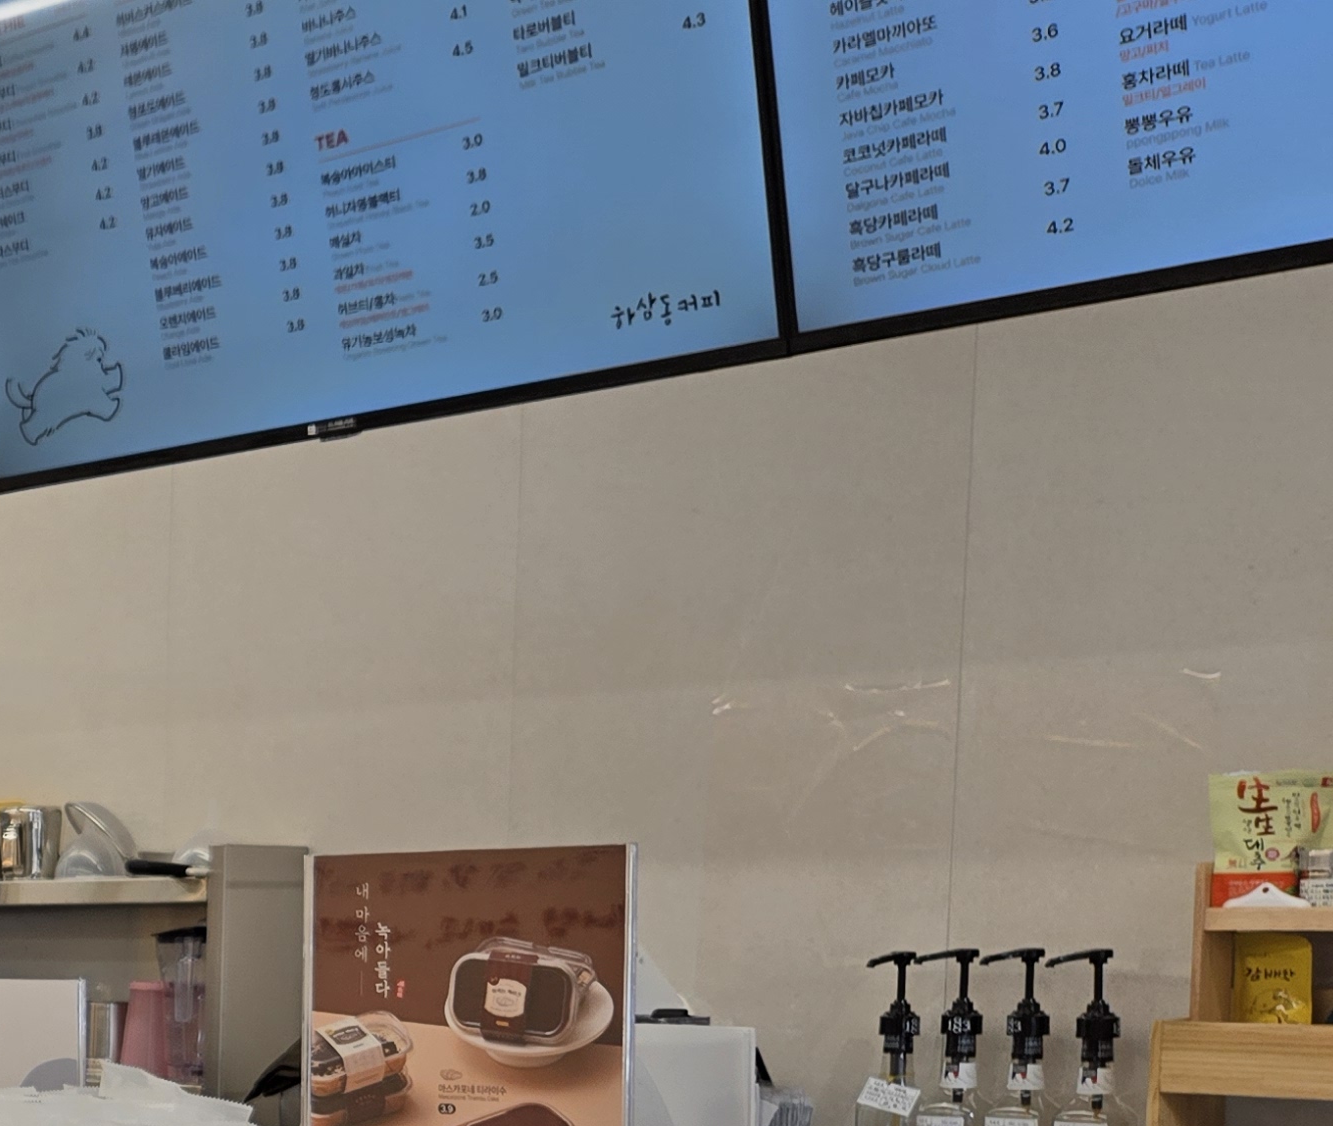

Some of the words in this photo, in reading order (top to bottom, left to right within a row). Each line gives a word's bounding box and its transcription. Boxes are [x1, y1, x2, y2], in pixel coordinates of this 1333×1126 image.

[450, 4, 468, 21] 4.1
[682, 12, 706, 30] 4.3
[1031, 22, 1059, 43] 3.6
[1119, 14, 1188, 46] 요거라떼
[452, 40, 474, 57] 4.5
[836, 62, 895, 90] 카페모카
[1034, 62, 1061, 82] 3.8
[1122, 59, 1190, 91] 홍차라떼
[839, 88, 943, 127] 자바칩카페모카
[1038, 101, 1064, 120] 3.7
[314, 128, 350, 151] TEA
[462, 133, 483, 151] 3.0
[842, 126, 947, 164] 코코넛카페라떼
[1039, 138, 1067, 156] 4.0
[1127, 147, 1196, 176] 돌체우유
[1043, 178, 1070, 197] 3.7
[849, 203, 938, 236] 흑당카페라떼
[1046, 218, 1074, 235] 4.2
[852, 241, 941, 274] 흑당구름라떼
[482, 307, 503, 323] 3.0
[356, 883, 369, 900] 내
[355, 906, 370, 963] 마음에
[374, 922, 391, 999] 녹아들다
[440, 1104, 455, 1114] 3.9
